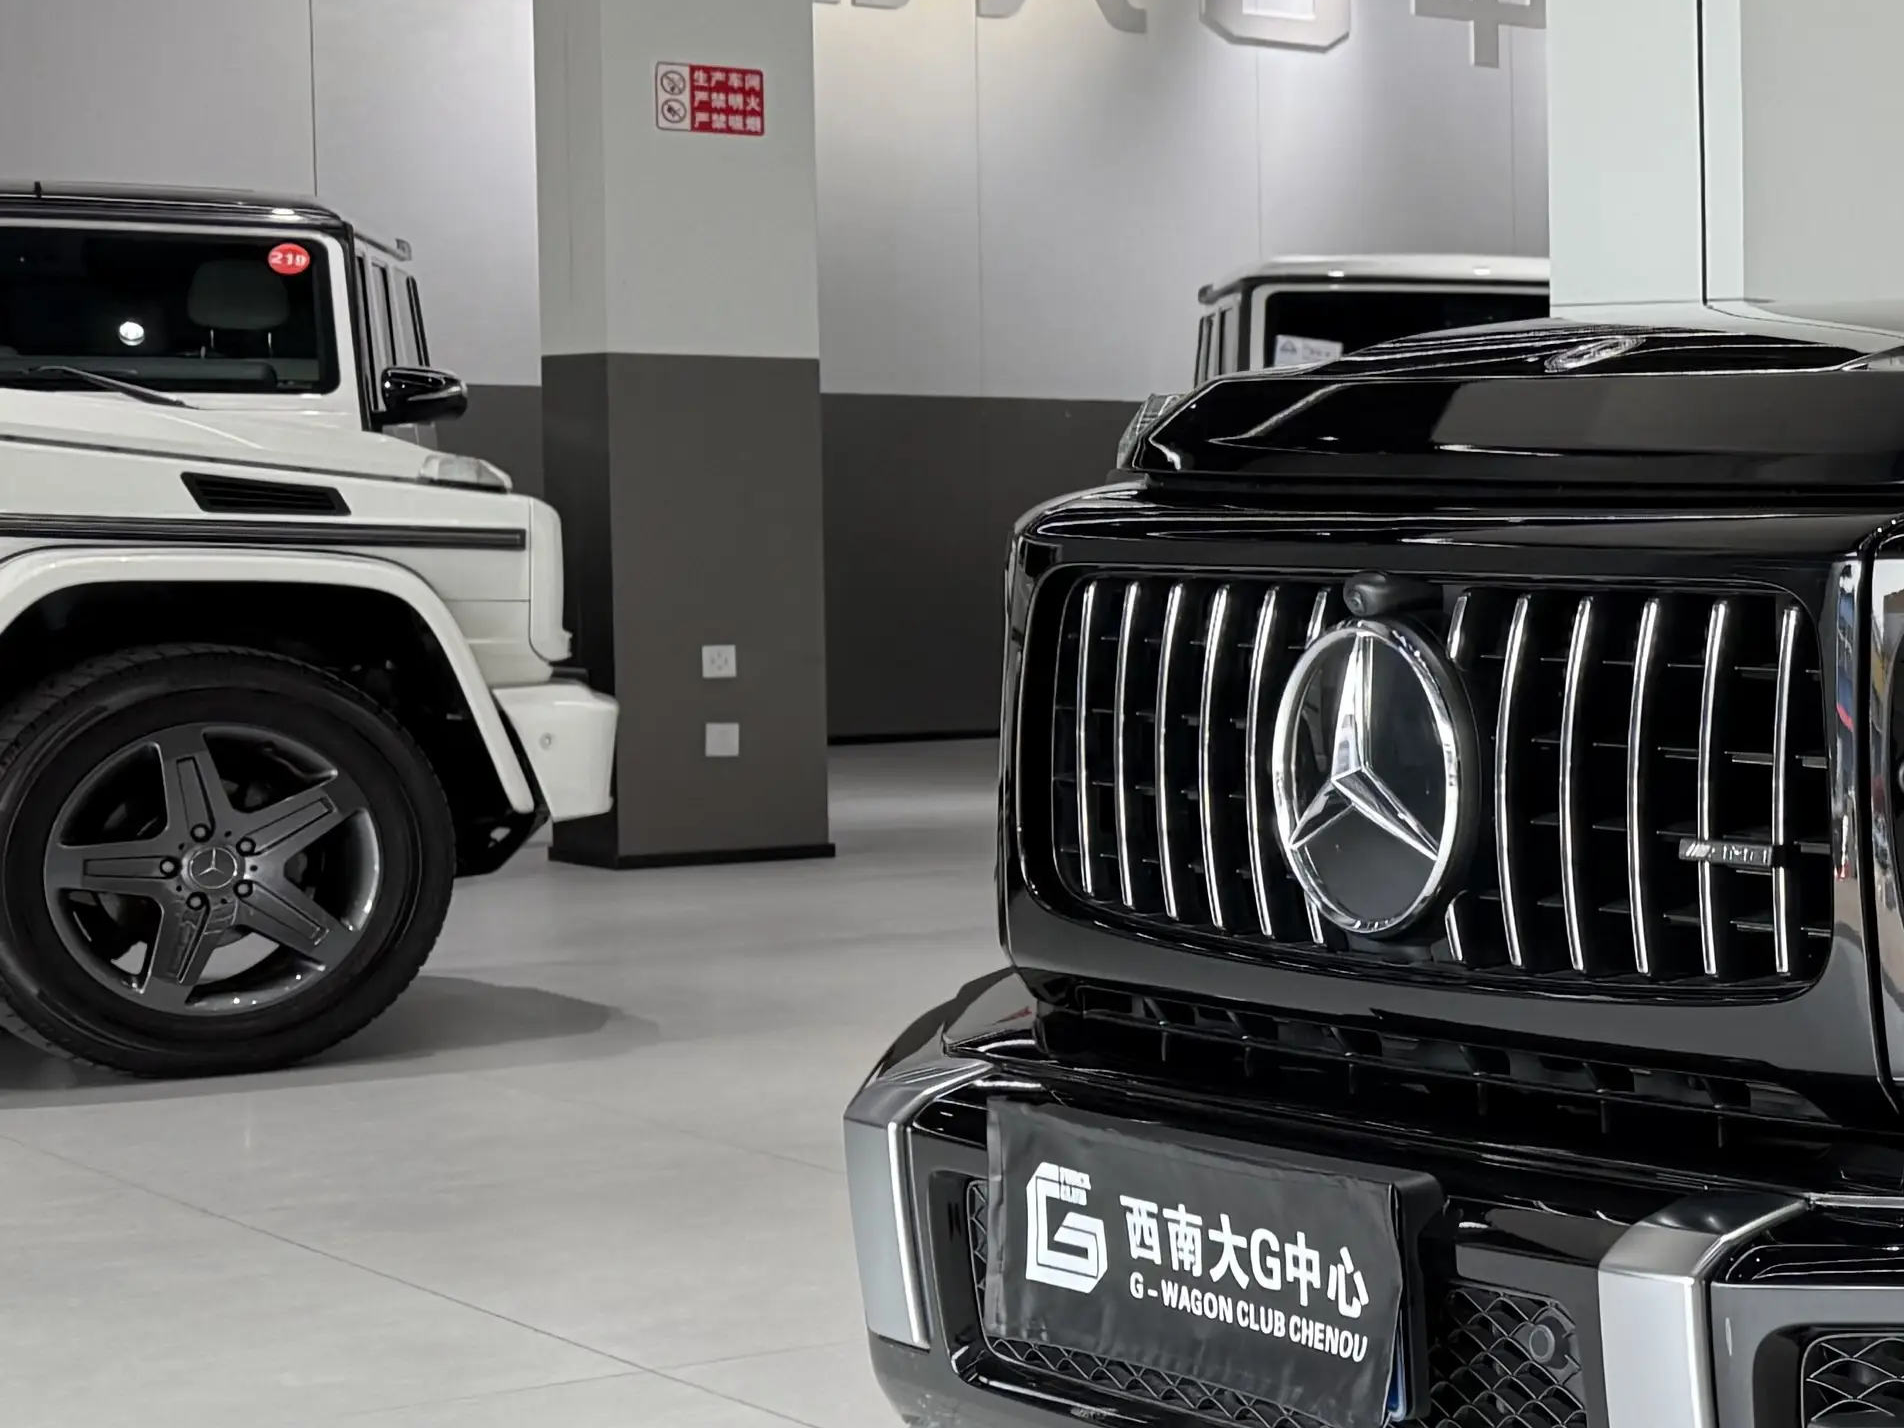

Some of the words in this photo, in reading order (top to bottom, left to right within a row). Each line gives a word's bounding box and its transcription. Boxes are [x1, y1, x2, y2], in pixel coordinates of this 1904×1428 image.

[1119, 1194, 1370, 1319] 西南大G中心
[1236, 1300, 1286, 1338] CLUB
